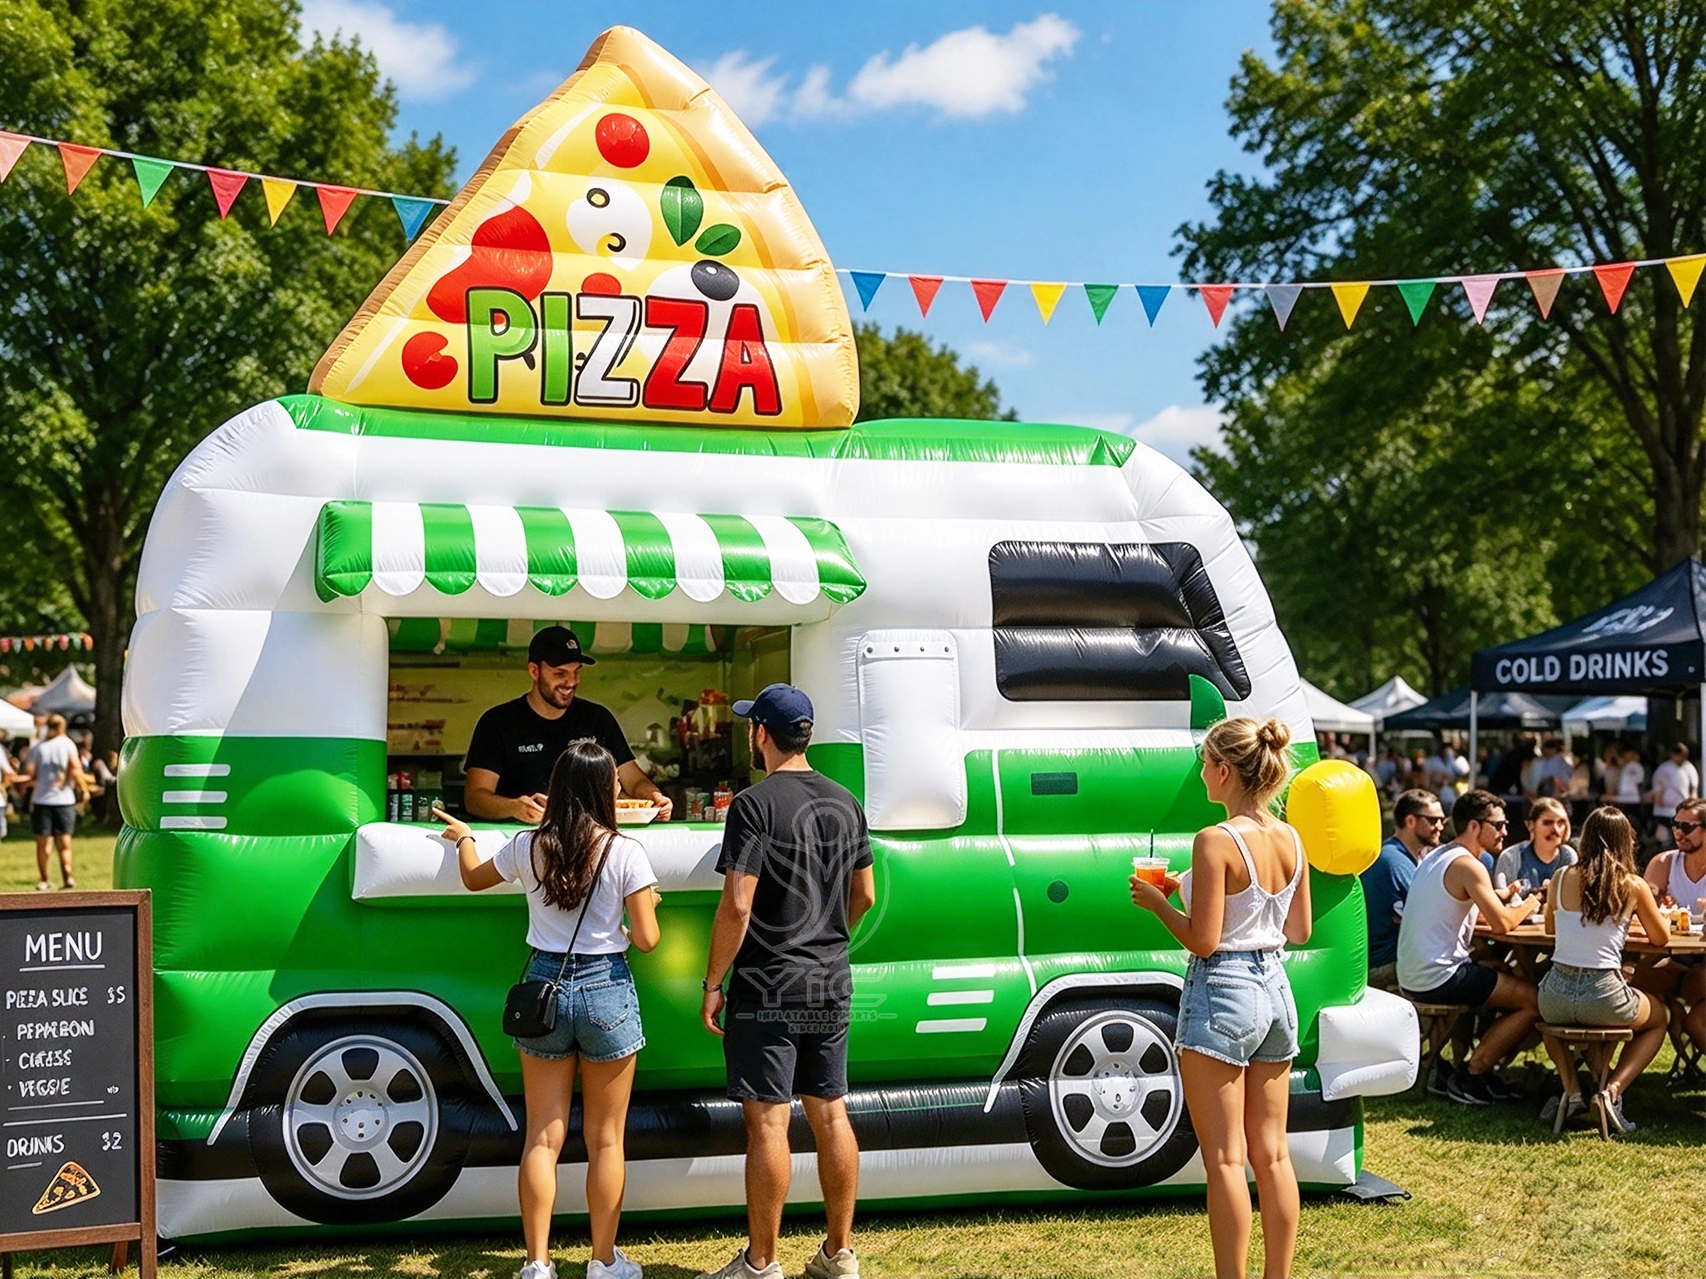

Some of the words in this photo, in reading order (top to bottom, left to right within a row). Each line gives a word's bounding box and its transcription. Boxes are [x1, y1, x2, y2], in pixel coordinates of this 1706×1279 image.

[466, 287, 783, 416] PIZZA
[1496, 655, 1562, 685] COLD
[1569, 649, 1670, 681] DRINKS
[25, 931, 102, 962] MENU
